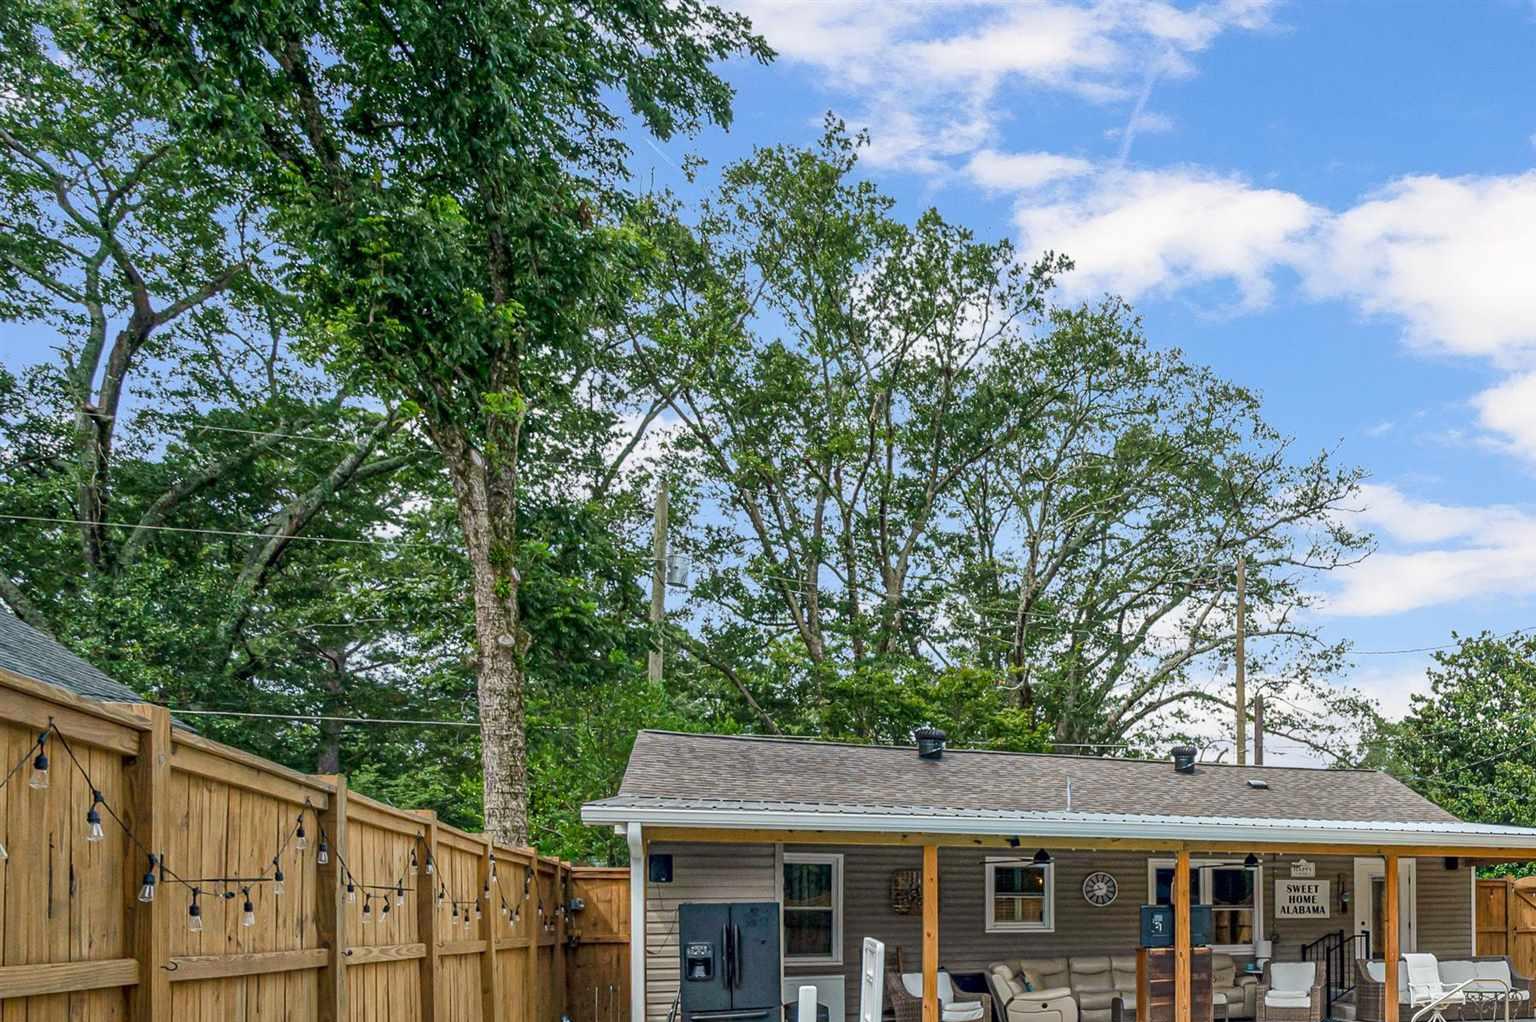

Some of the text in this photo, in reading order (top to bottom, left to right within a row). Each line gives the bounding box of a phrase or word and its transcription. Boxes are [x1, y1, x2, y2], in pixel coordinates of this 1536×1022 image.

[1286, 884, 1319, 893] SWEET
[1288, 895, 1318, 904] HOME
[1280, 905, 1326, 914] ALABAMA
